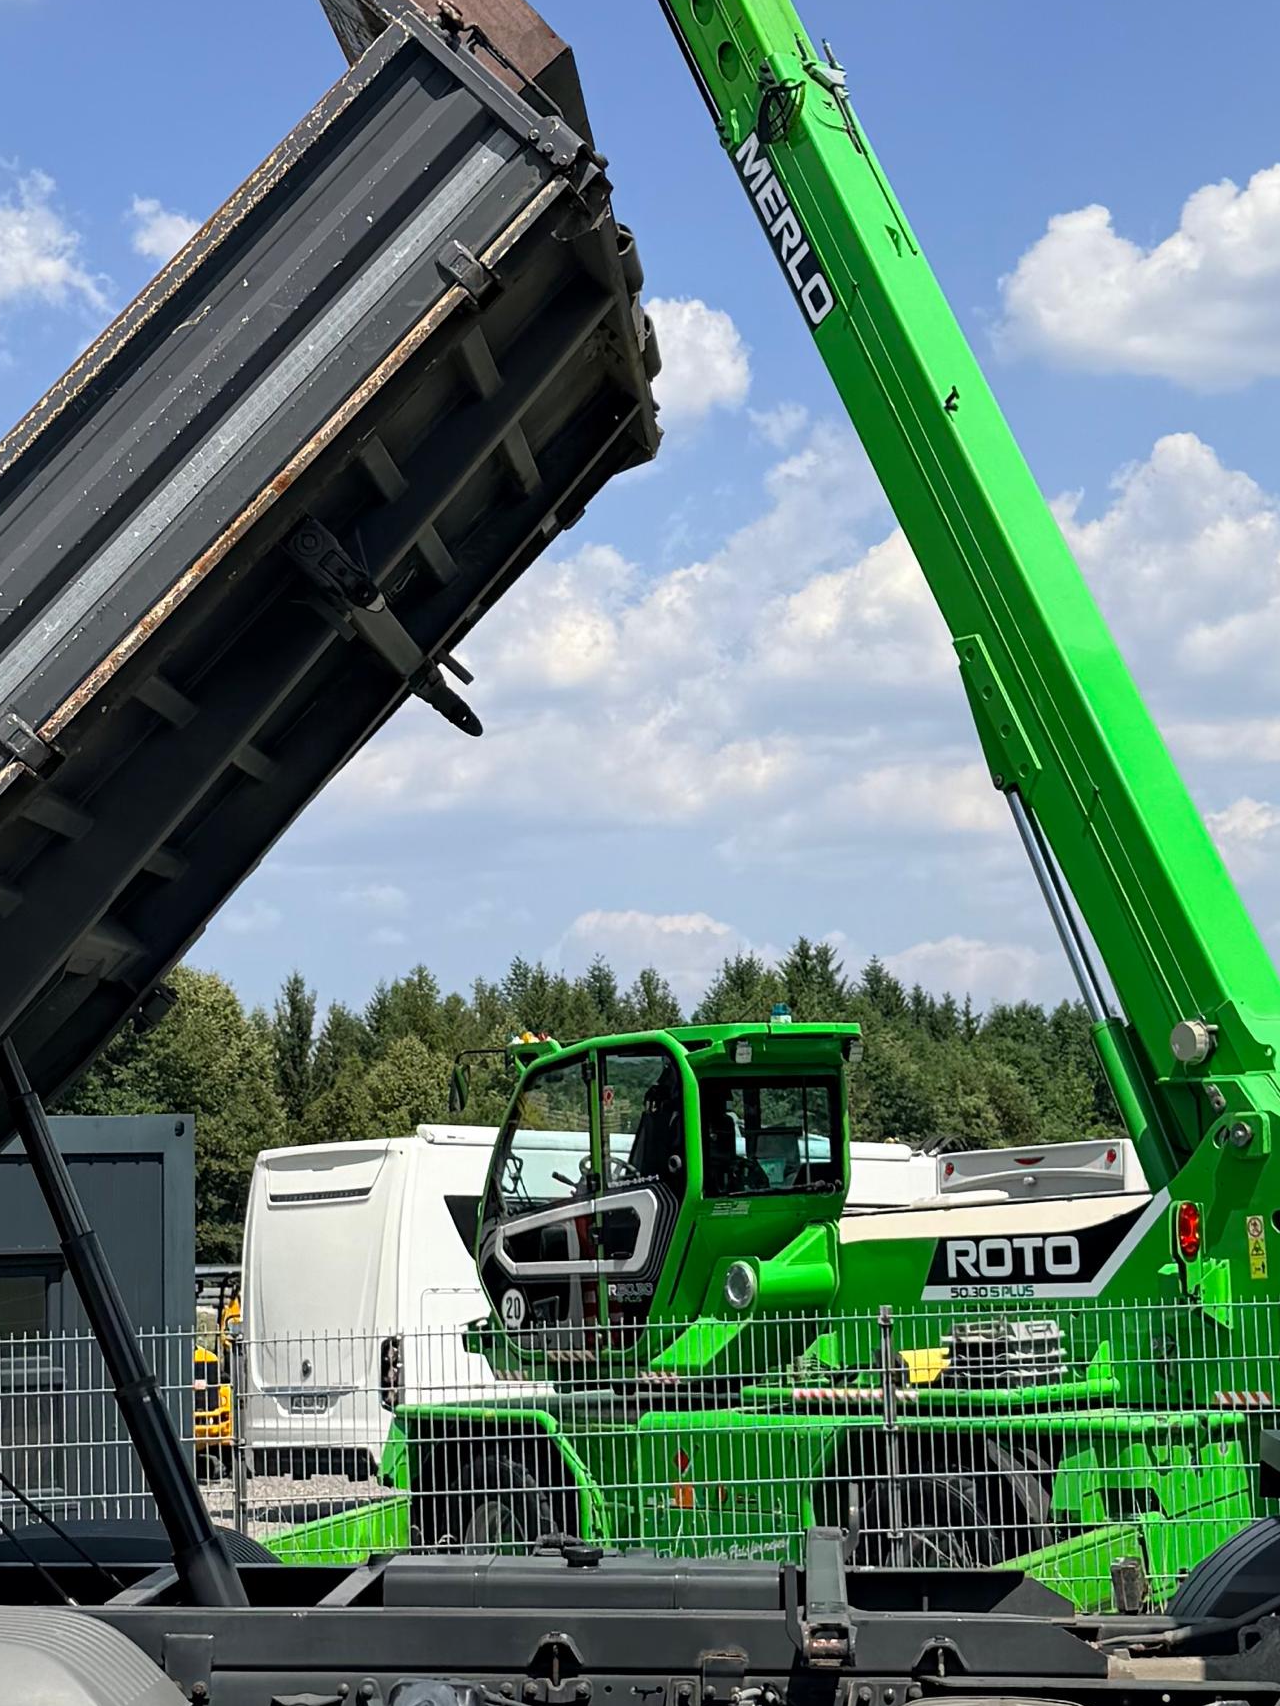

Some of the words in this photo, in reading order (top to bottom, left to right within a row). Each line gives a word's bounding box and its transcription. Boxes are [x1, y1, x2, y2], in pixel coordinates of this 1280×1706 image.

[735, 132, 834, 325] MERLO
[946, 1235, 1081, 1278] ROTO
[505, 1295, 522, 1321] 20
[950, 1286, 988, 1299] 50.30
[1001, 1284, 1035, 1298] PLUS
